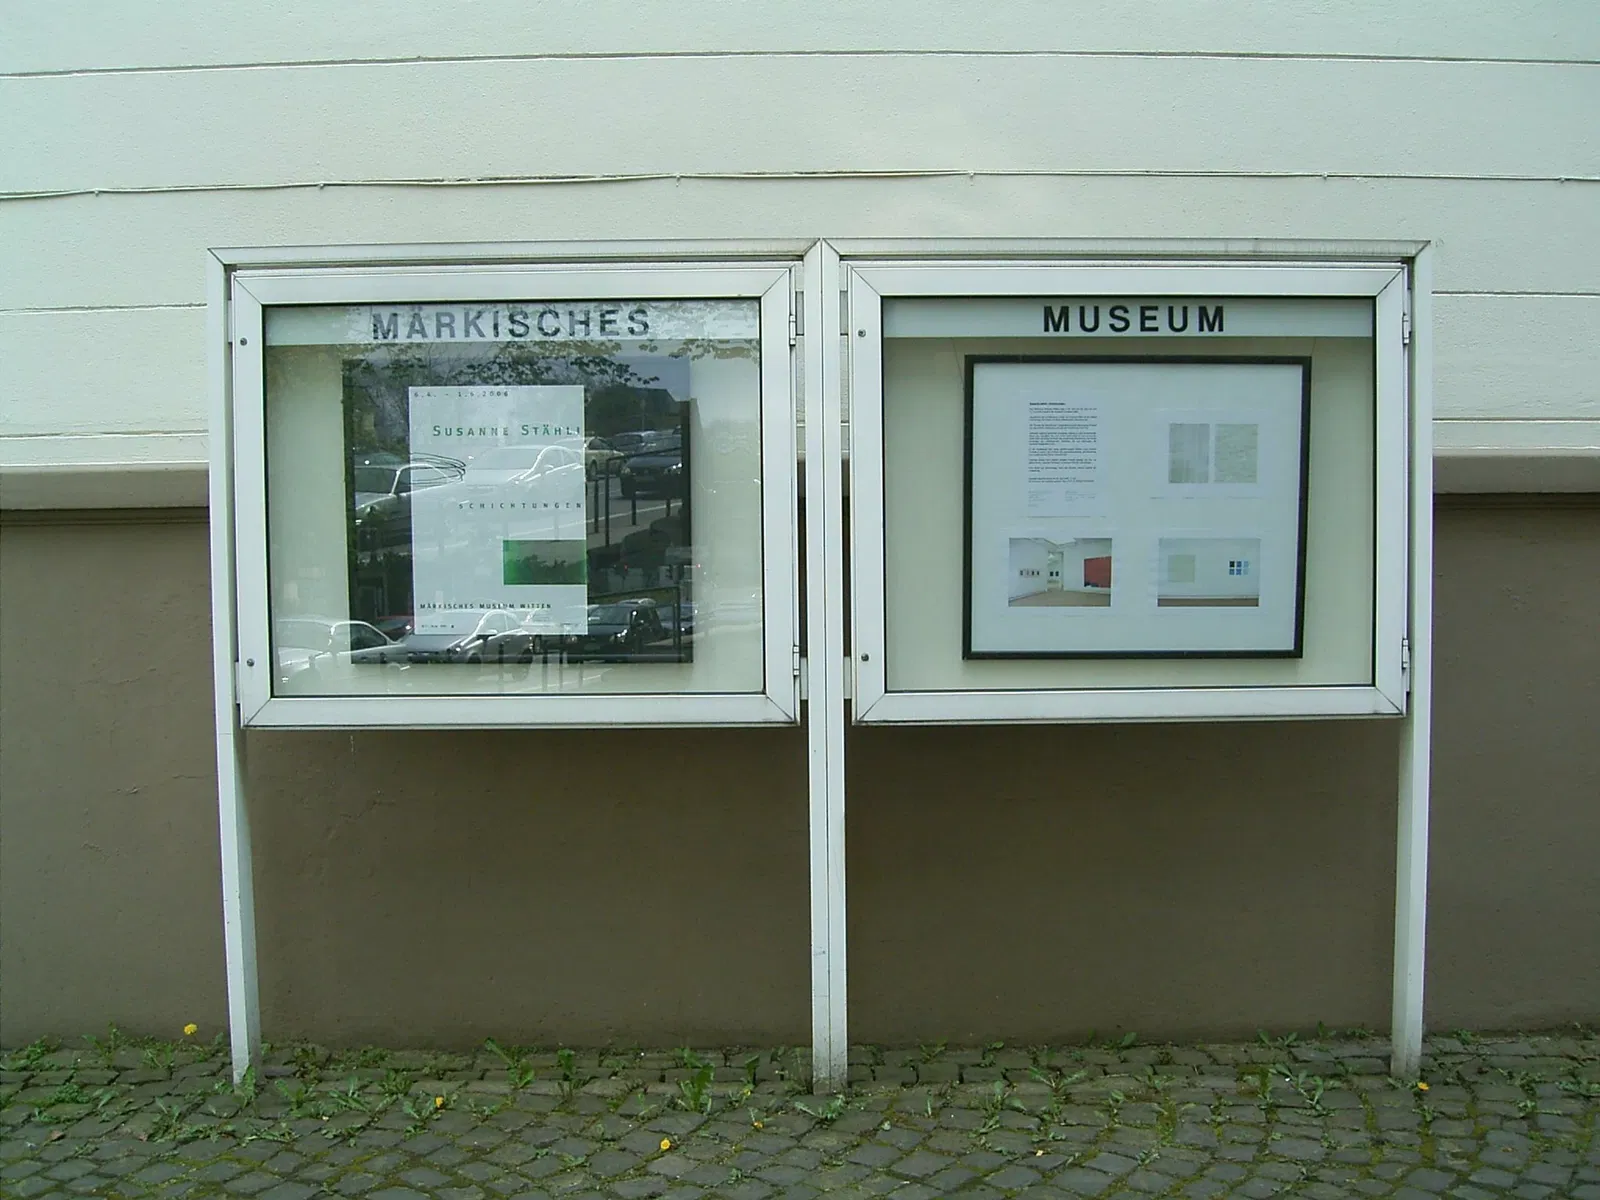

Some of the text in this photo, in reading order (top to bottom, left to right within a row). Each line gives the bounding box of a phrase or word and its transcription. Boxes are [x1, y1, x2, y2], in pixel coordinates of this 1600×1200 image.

[372, 305, 650, 340] MÄRKISCHES
[1043, 305, 1224, 333] MUSEUM
[432, 424, 581, 437] SUSANNE STÄHLI
[458, 502, 582, 510] SCHICHTUNGEN
